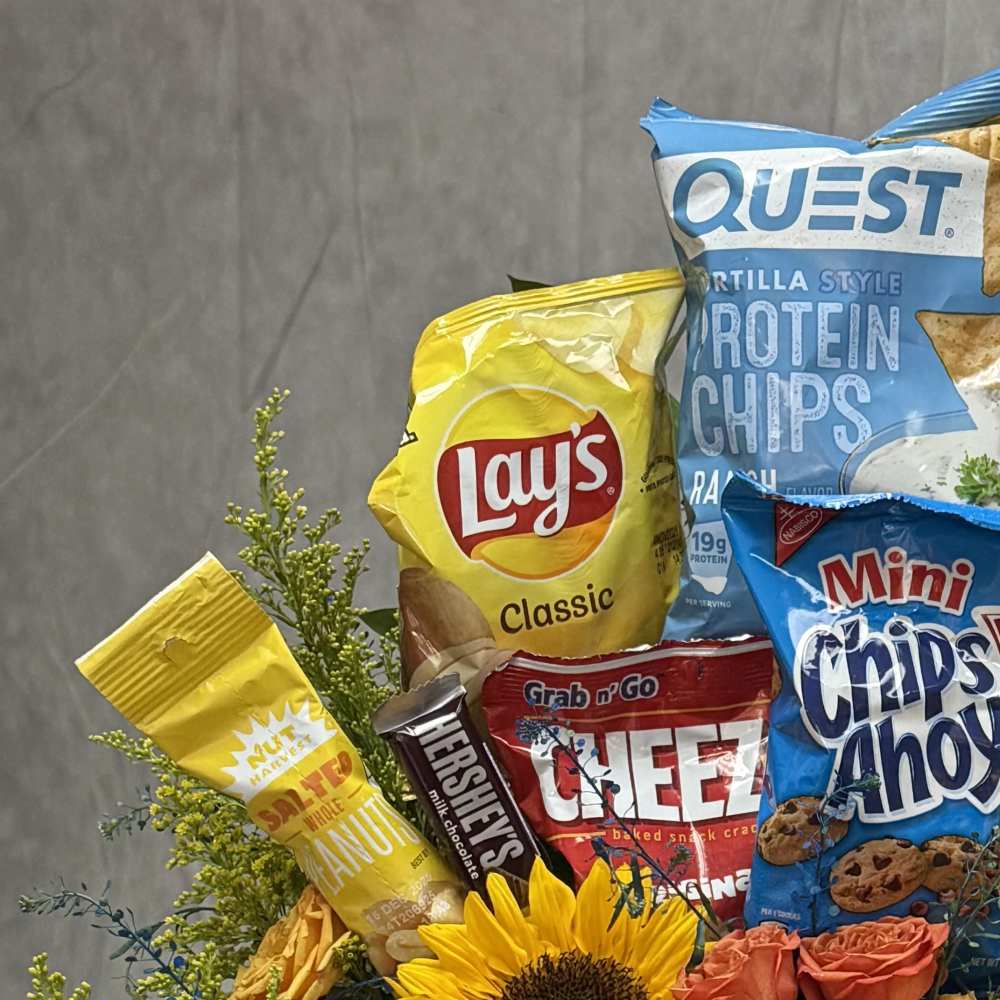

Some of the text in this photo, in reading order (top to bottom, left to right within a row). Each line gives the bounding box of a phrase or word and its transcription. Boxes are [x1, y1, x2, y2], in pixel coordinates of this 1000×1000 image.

[673, 158, 963, 238] QUEST
[706, 269, 902, 296] RTILLA STYLE
[691, 372, 873, 456] CHIPS
[457, 422, 608, 537] Lay's
[690, 554, 728, 564] PROTEIN
[692, 531, 726, 554] 19g
[820, 549, 973, 614] Mini
[499, 583, 615, 634] Classic
[524, 680, 590, 709] Grab
[619, 674, 659, 701] Go
[801, 619, 995, 739] Chips
[246, 724, 296, 769] NUT
[250, 734, 313, 786] HARVEST
[257, 750, 353, 833] SALTED
[303, 798, 345, 833] WHOLE
[418, 719, 524, 870] HERSHEY'S
[428, 789, 480, 881] milk chocolate
[613, 824, 758, 844] baked snack crac
